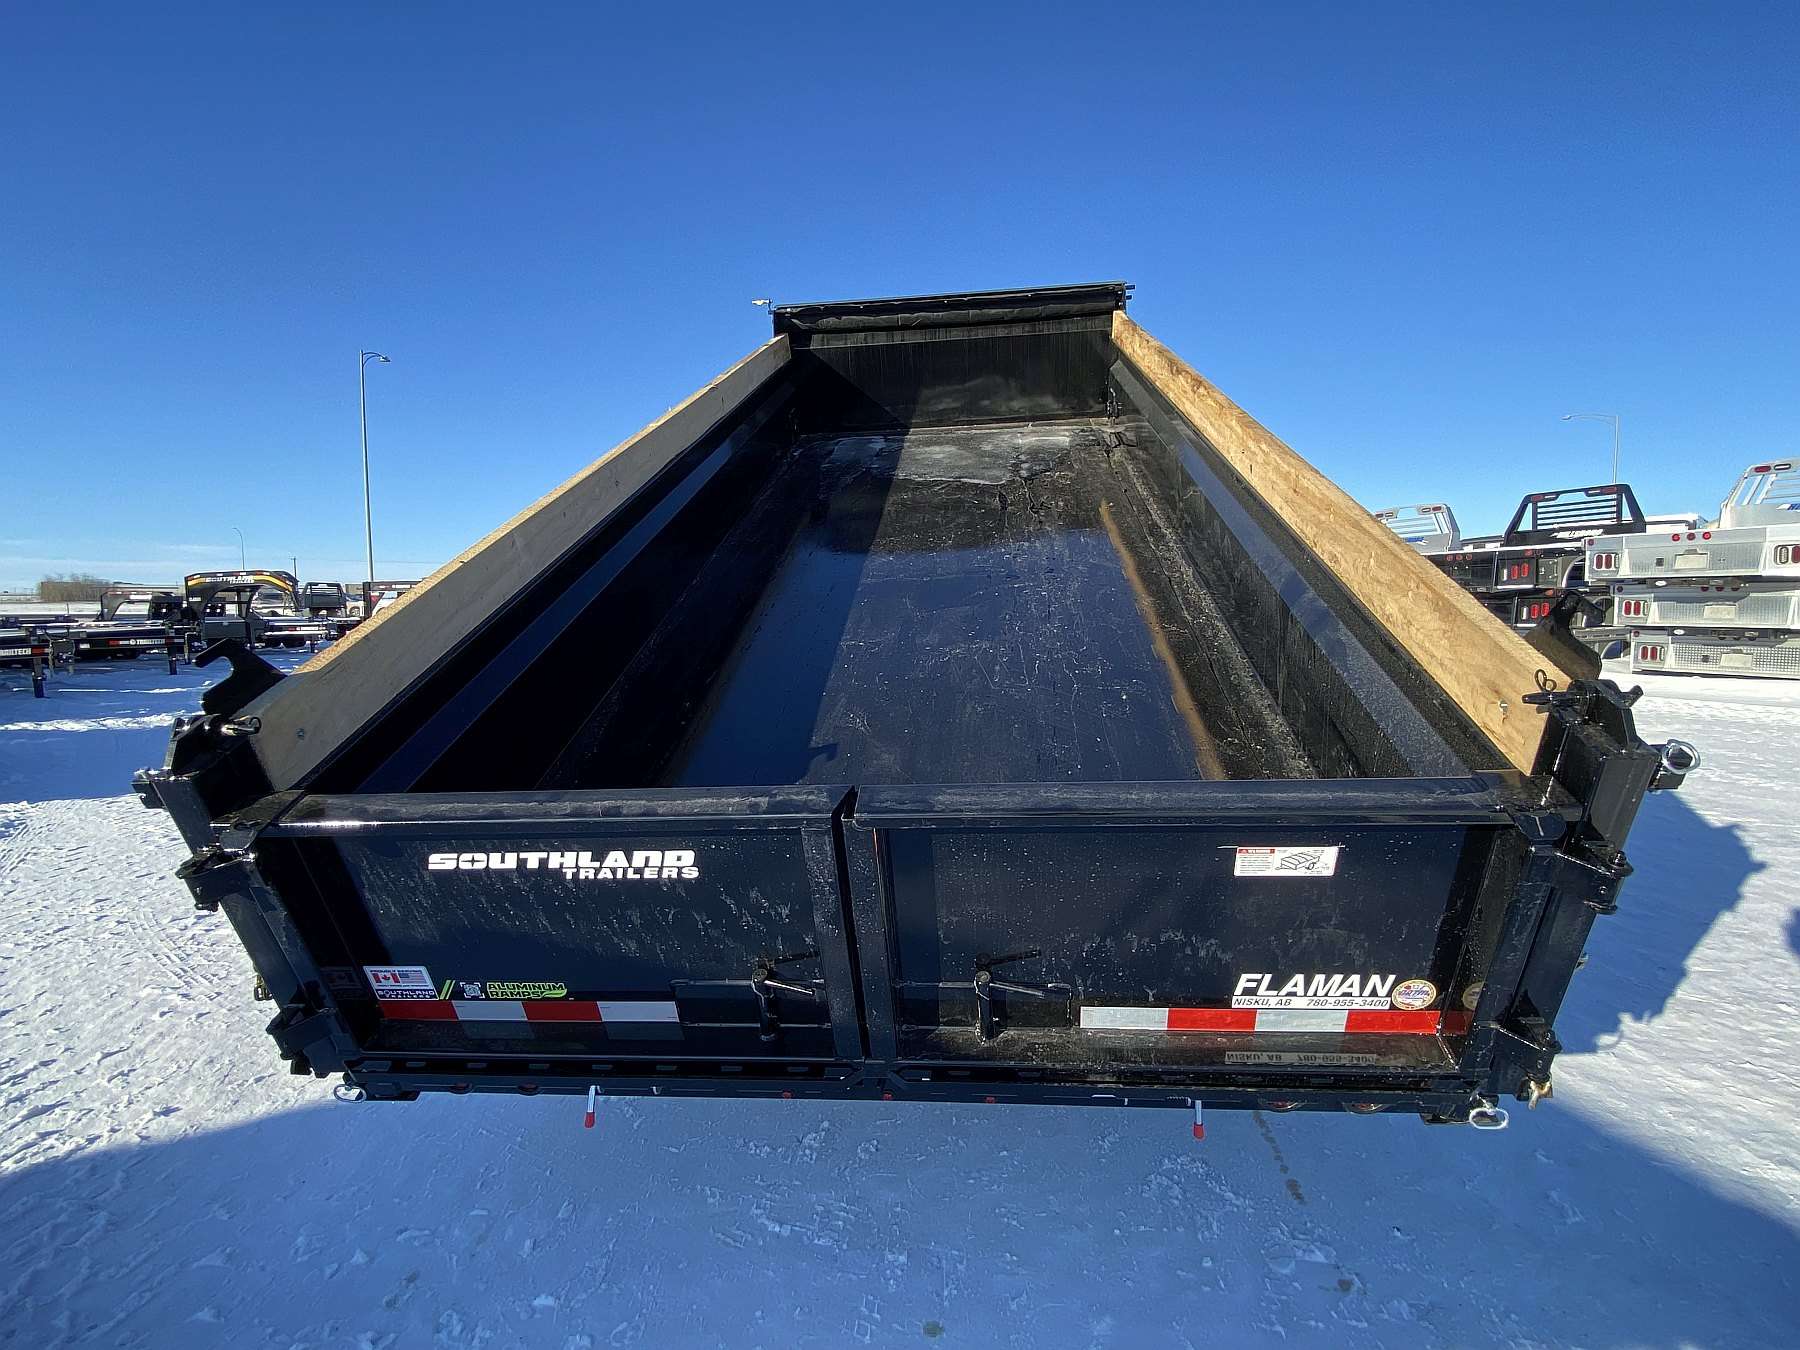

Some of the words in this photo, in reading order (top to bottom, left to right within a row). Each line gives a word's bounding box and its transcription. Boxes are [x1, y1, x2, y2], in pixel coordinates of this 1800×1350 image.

[428, 850, 696, 870] SOUTHLAND
[562, 866, 700, 880] TRAILERS
[487, 983, 565, 991] ALUMINUM
[1233, 973, 1397, 997] FLAMAN
[489, 990, 542, 998] RAMPS
[1233, 998, 1272, 1007] NISKU,
[1275, 998, 1292, 1007] AB
[1306, 998, 1389, 1008] 780-955-3400
